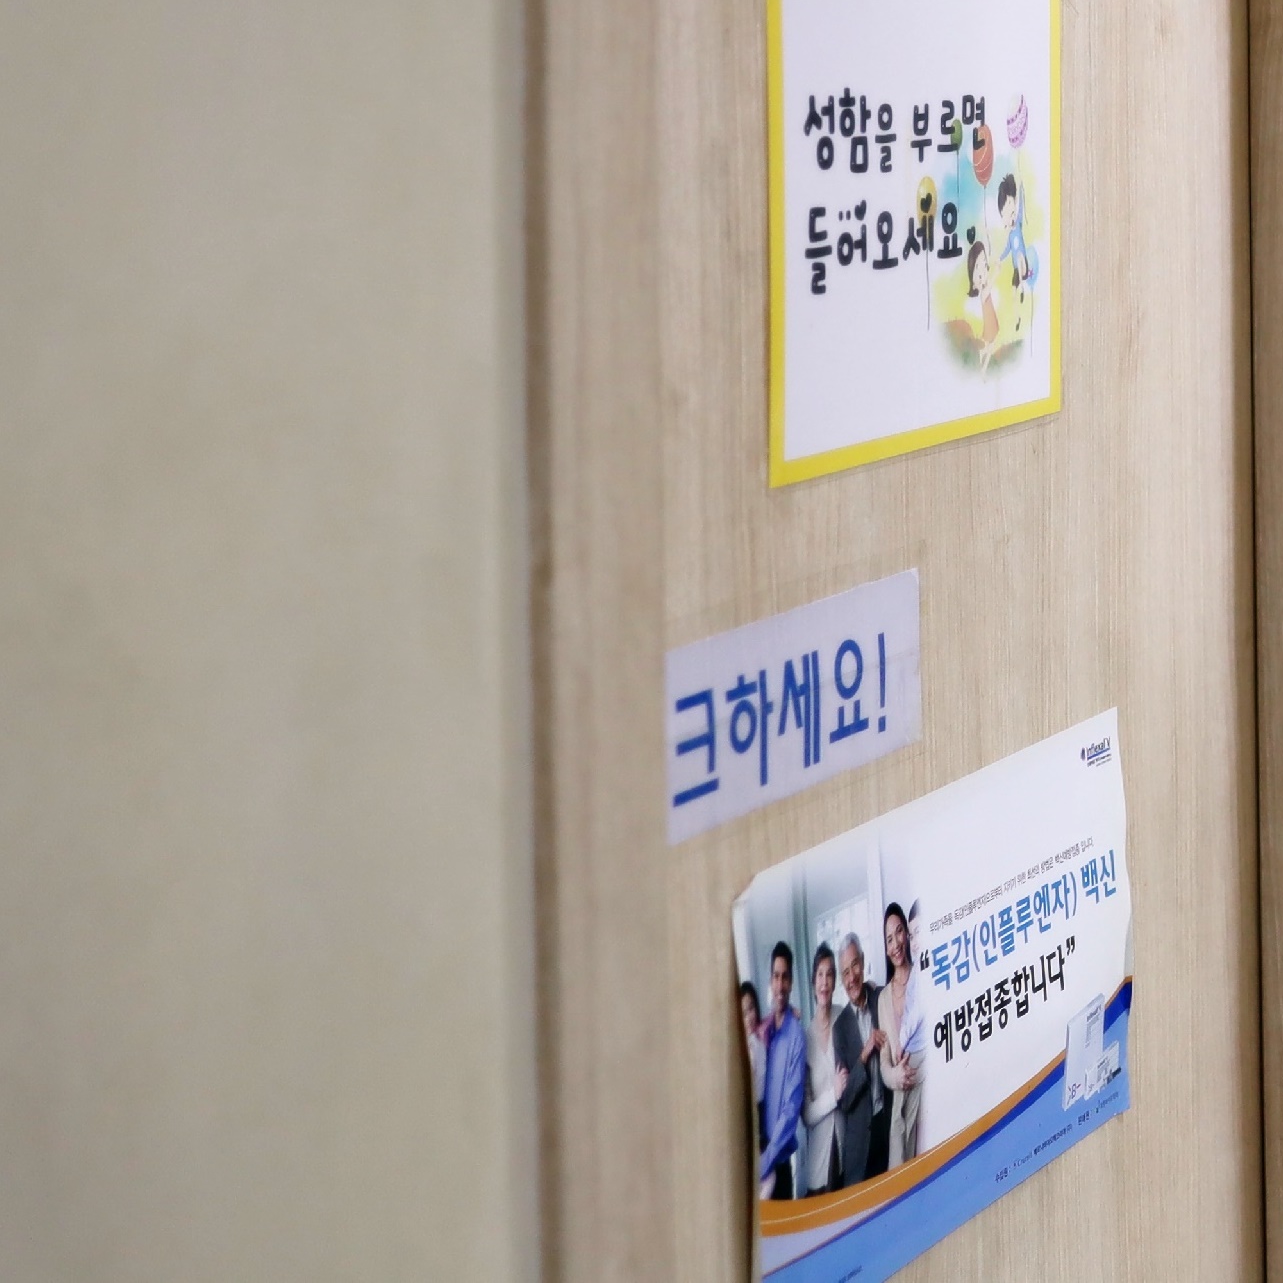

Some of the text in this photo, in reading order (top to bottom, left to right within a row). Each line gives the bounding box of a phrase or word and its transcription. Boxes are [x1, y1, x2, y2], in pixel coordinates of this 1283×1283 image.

[804, 87, 985, 173] 성함을 부르면
[673, 631, 887, 807] 크하세요!
[1080, 849, 1117, 904] 백신
